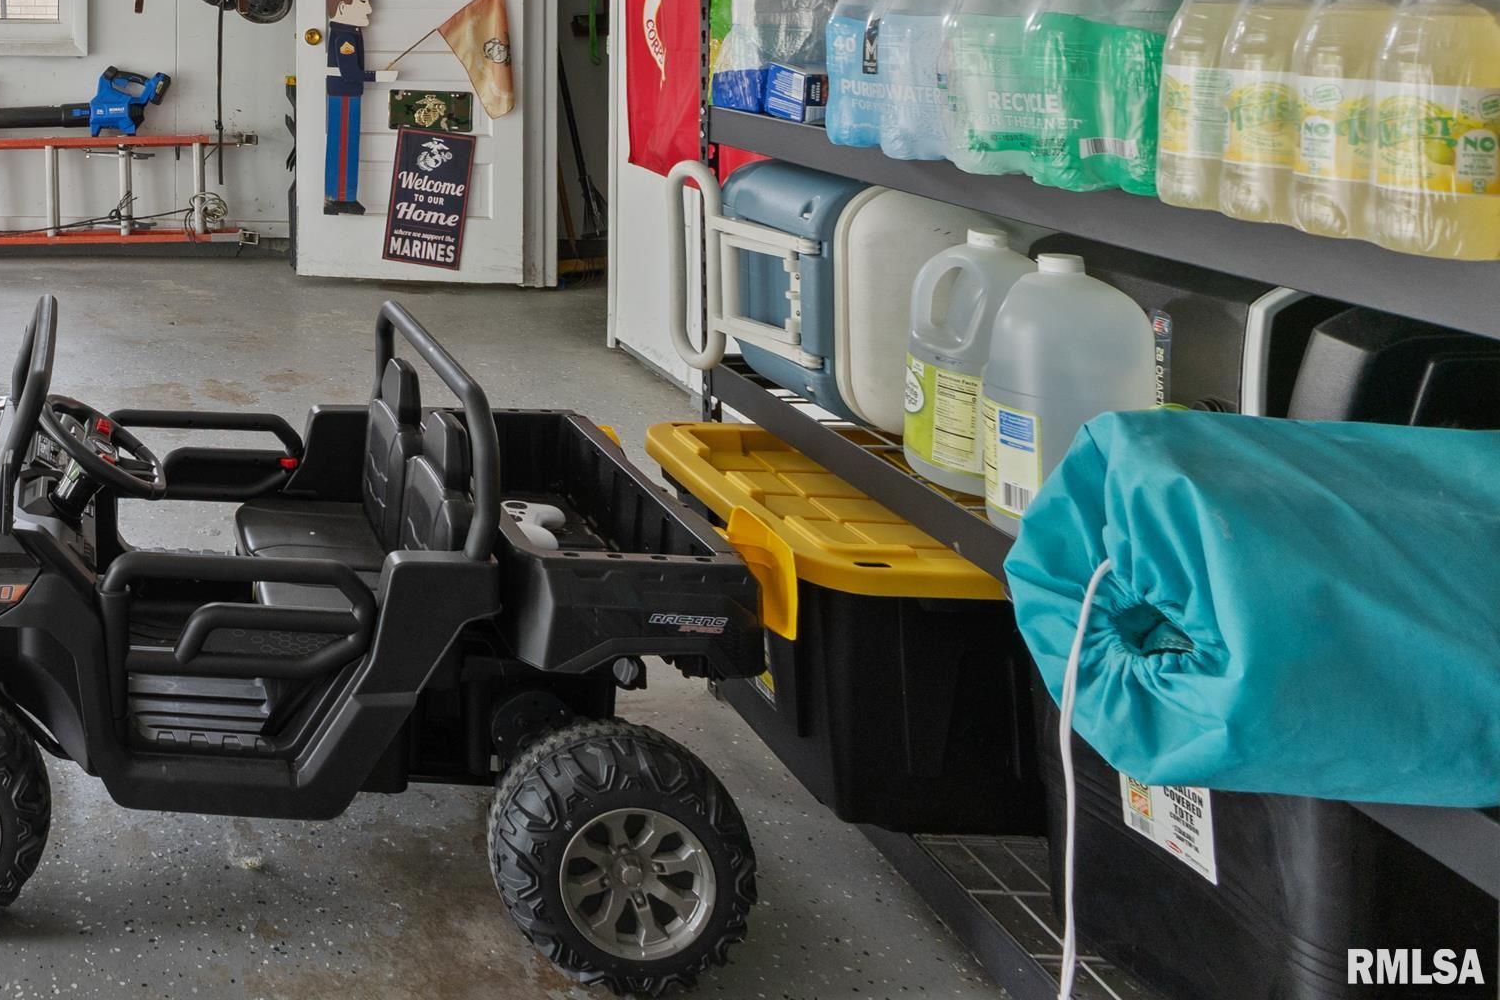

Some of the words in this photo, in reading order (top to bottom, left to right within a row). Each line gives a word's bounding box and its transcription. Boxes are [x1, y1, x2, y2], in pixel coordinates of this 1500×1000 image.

[886, 83, 942, 105] WATER
[987, 90, 1060, 114] RECYCLE
[969, 111, 1001, 126] FOR
[1462, 135, 1497, 153] NO
[398, 170, 465, 197] Welcome
[414, 193, 425, 203] TO
[428, 196, 445, 206] OUR
[396, 201, 460, 227] Home
[393, 228, 411, 237] where
[421, 232, 445, 241] support
[444, 235, 455, 243] the
[389, 236, 456, 263] MARINES
[1156, 346, 1165, 362] 28
[649, 613, 729, 627] RACING
[1163, 785, 1202, 819] COVERED
[1173, 802, 1195, 826] TOTE
